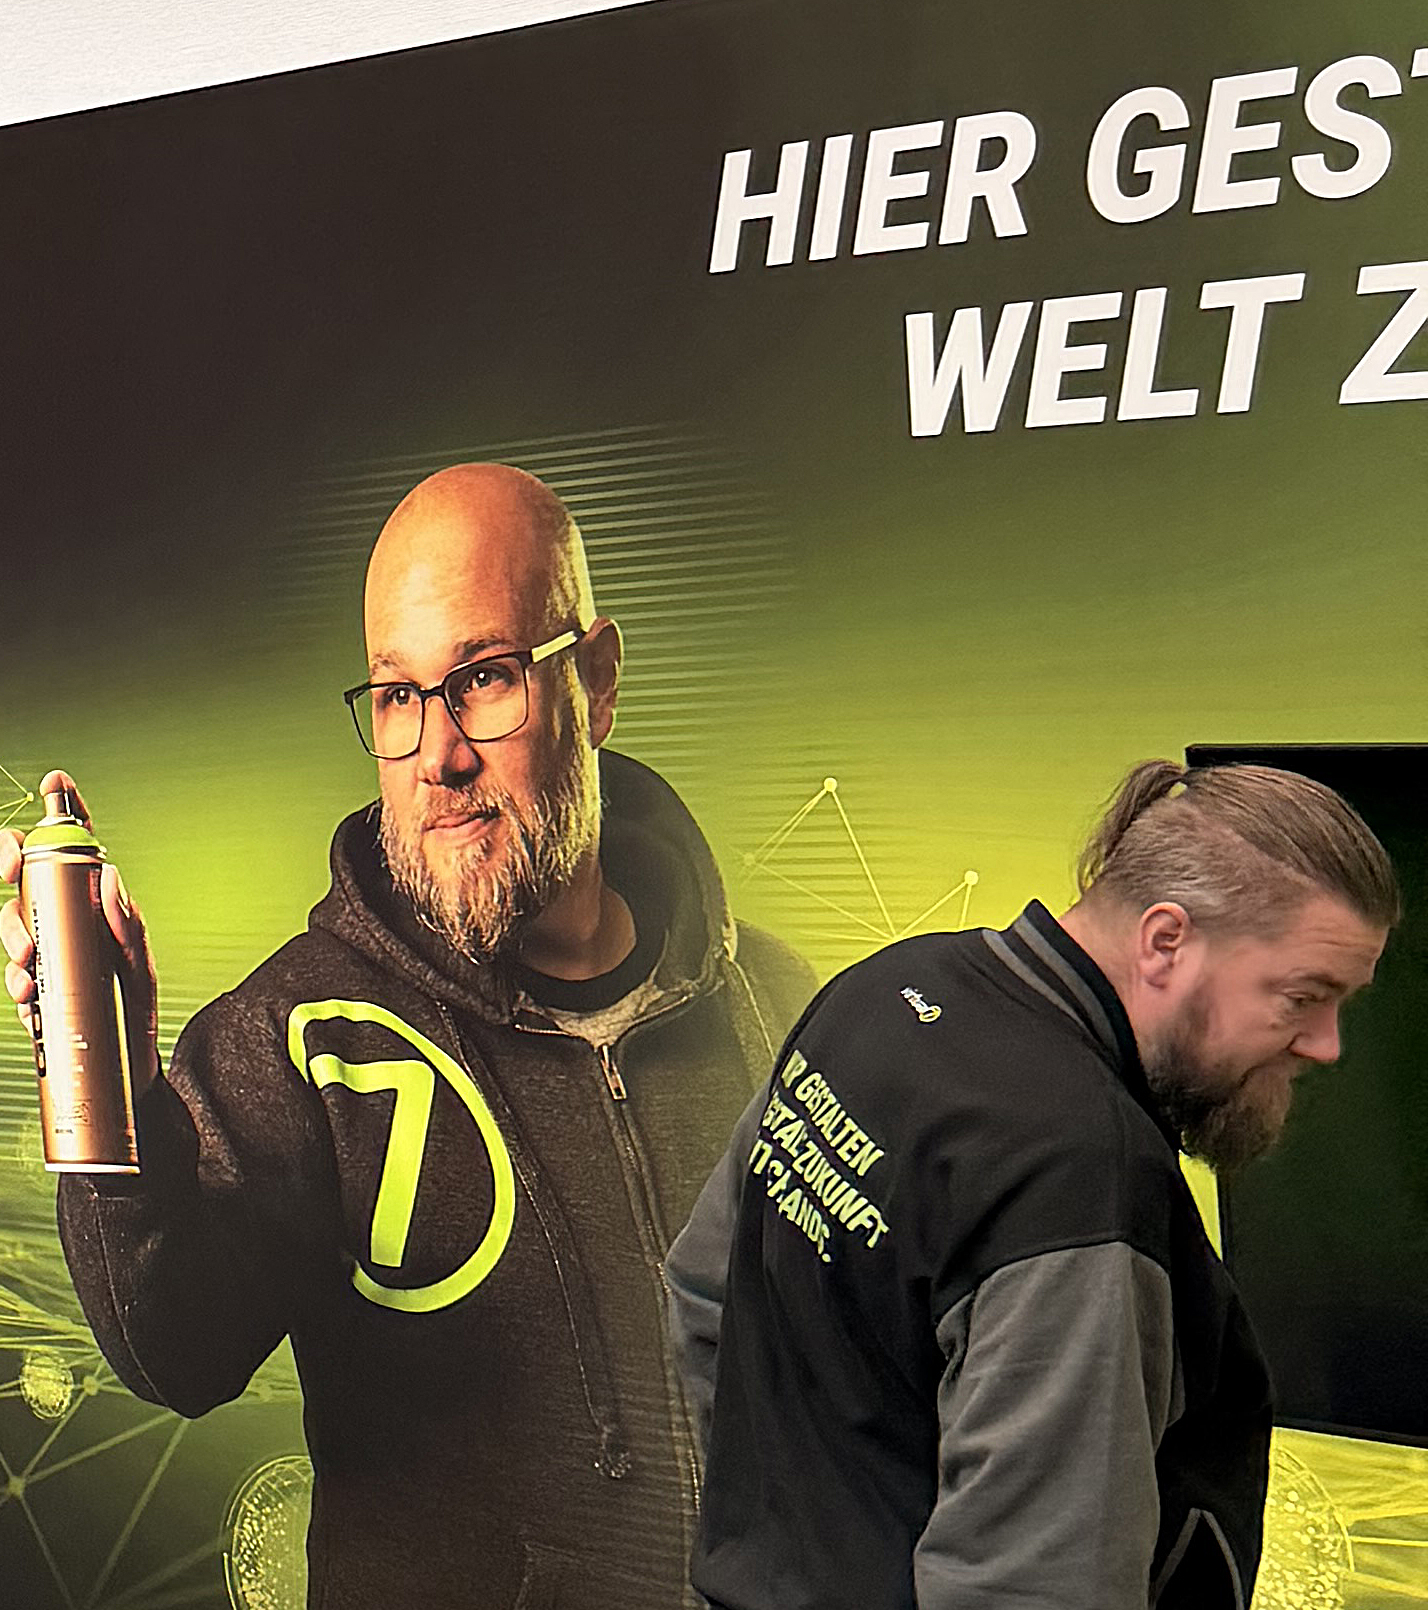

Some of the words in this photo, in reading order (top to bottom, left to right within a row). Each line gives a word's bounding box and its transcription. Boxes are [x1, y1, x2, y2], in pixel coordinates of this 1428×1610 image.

[709, 110, 1037, 274] HIER
[1086, 48, 1428, 224] GES
[904, 272, 1306, 437] WELT
